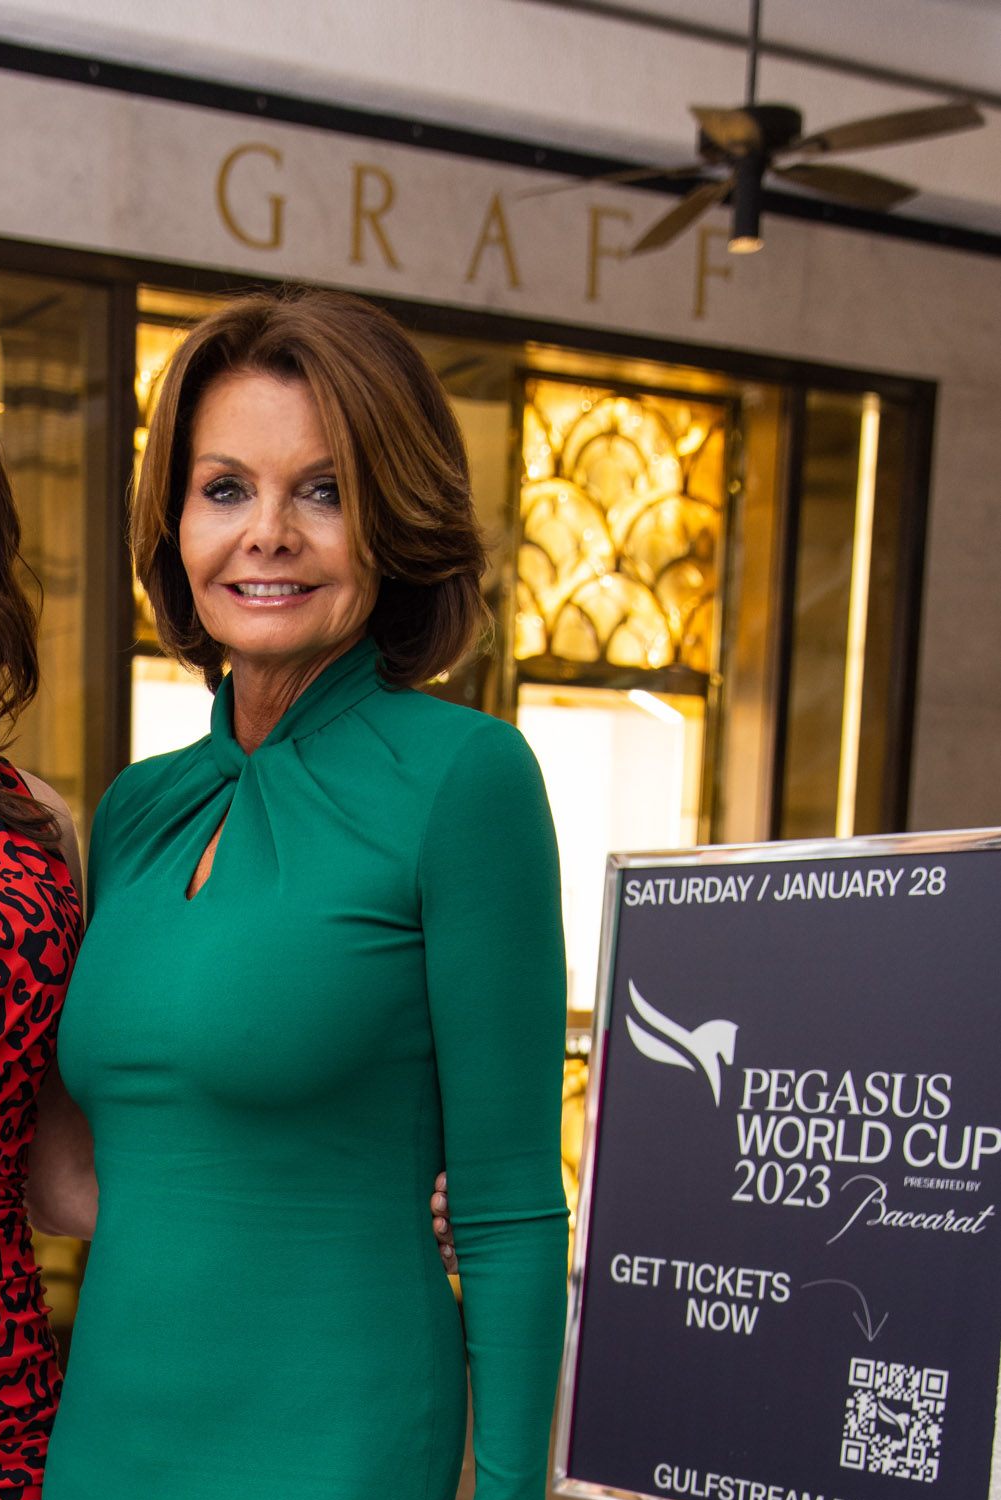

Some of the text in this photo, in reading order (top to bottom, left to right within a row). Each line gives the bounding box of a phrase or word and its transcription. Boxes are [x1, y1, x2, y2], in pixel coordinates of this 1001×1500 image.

[215, 141, 735, 320] GRAFF
[624, 874, 754, 906] SATURDAY
[774, 867, 904, 900] JANUARY
[908, 866, 947, 897] 28
[740, 1067, 952, 1119] PEGASUS
[737, 1114, 1001, 1171] WORLD CUP
[732, 1160, 831, 1208] 2023
[903, 1176, 982, 1192] PRESENTED BY
[826, 1173, 996, 1245] Baccarat
[610, 1254, 791, 1303] GET TICKETS
[686, 1299, 759, 1335] NOW
